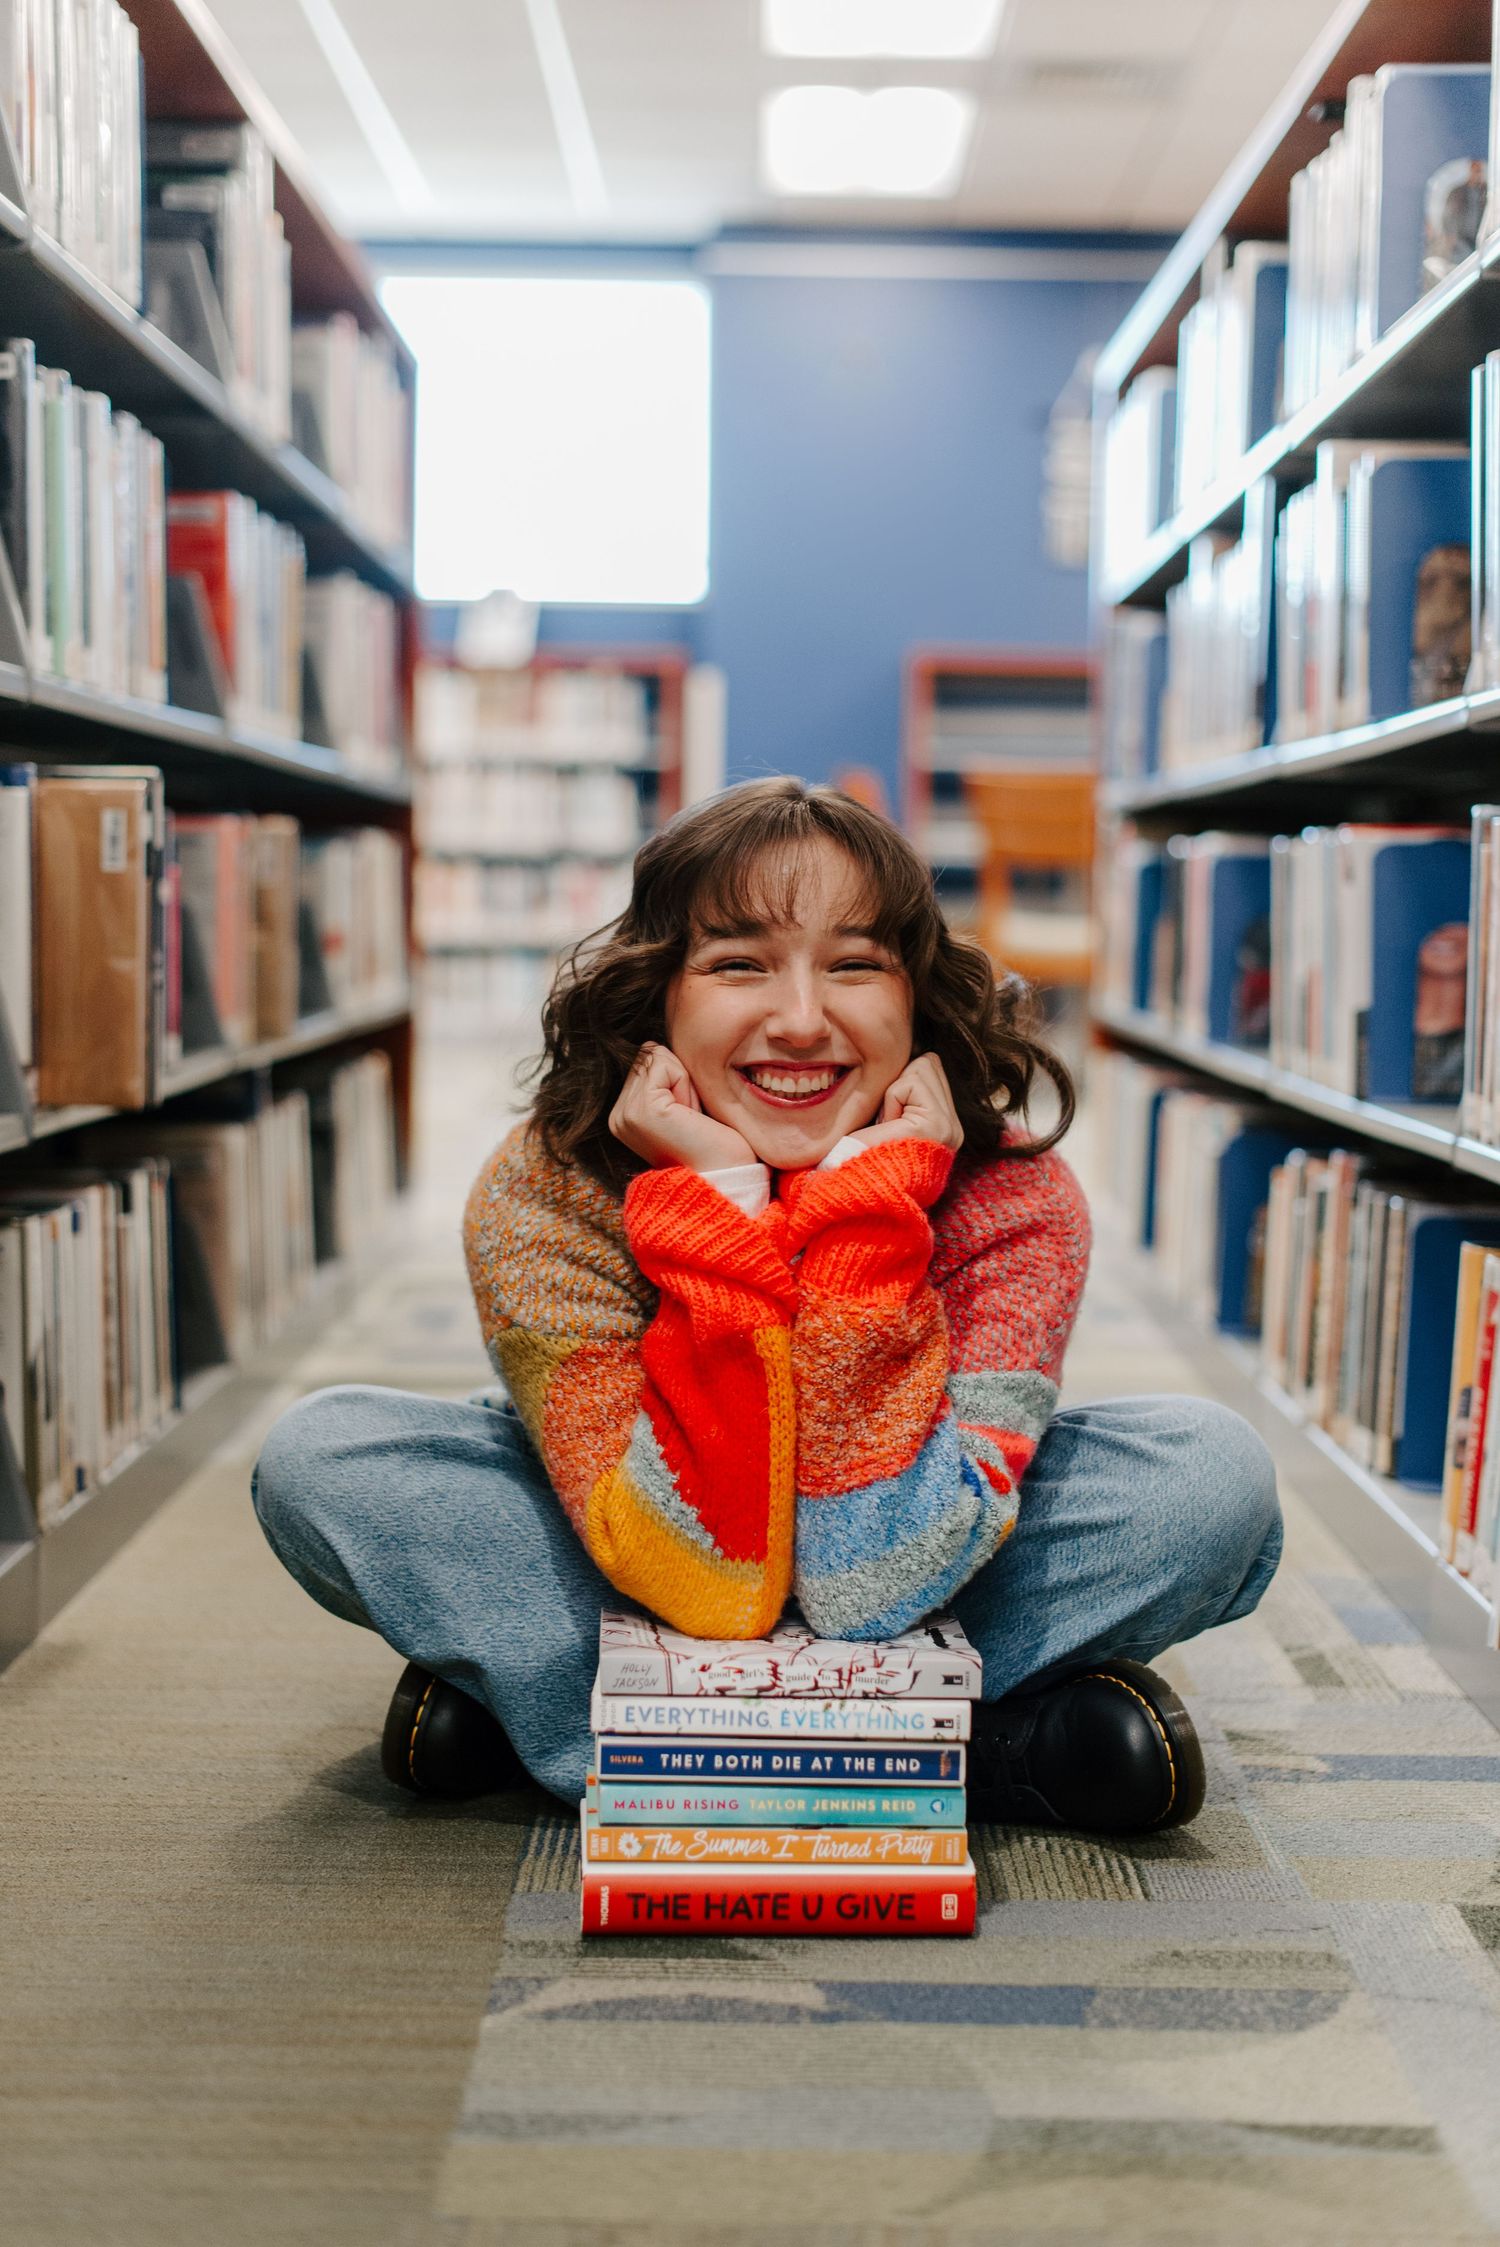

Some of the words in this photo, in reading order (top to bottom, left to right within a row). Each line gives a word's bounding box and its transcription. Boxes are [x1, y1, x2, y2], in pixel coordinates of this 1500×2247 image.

[621, 1663, 652, 1674] HOLLY
[708, 1669, 732, 1681] good
[740, 1667, 764, 1680] girl's
[785, 1670, 812, 1683] guide
[821, 1672, 831, 1681] to
[855, 1672, 890, 1685] murder
[612, 1677, 659, 1690] JACKSON
[780, 1709, 925, 1730] EVERYTHING
[609, 1755, 644, 1764] SILVERA
[661, 1754, 704, 1768] THEY
[714, 1755, 762, 1769] BOTH
[772, 1756, 801, 1770] DIE
[811, 1757, 833, 1771] AT
[843, 1757, 876, 1771] THE
[885, 1758, 921, 1772] END
[614, 1800, 675, 1809] MALIBU
[683, 1800, 740, 1810] RISING
[750, 1800, 806, 1811] TAYLOR
[812, 1800, 876, 1811] JENKINS
[882, 1800, 917, 1811] REID
[643, 1833, 684, 1860] The
[684, 1830, 771, 1860] Summer
[772, 1834, 799, 1858] I
[802, 1834, 871, 1860] Turned
[876, 1833, 936, 1864] Pretty
[600, 1885, 610, 1926] THOMAS
[626, 1893, 691, 1920] THE
[704, 1893, 790, 1920] HATE
[802, 1893, 823, 1921] U
[836, 1893, 916, 1921] GIVE
